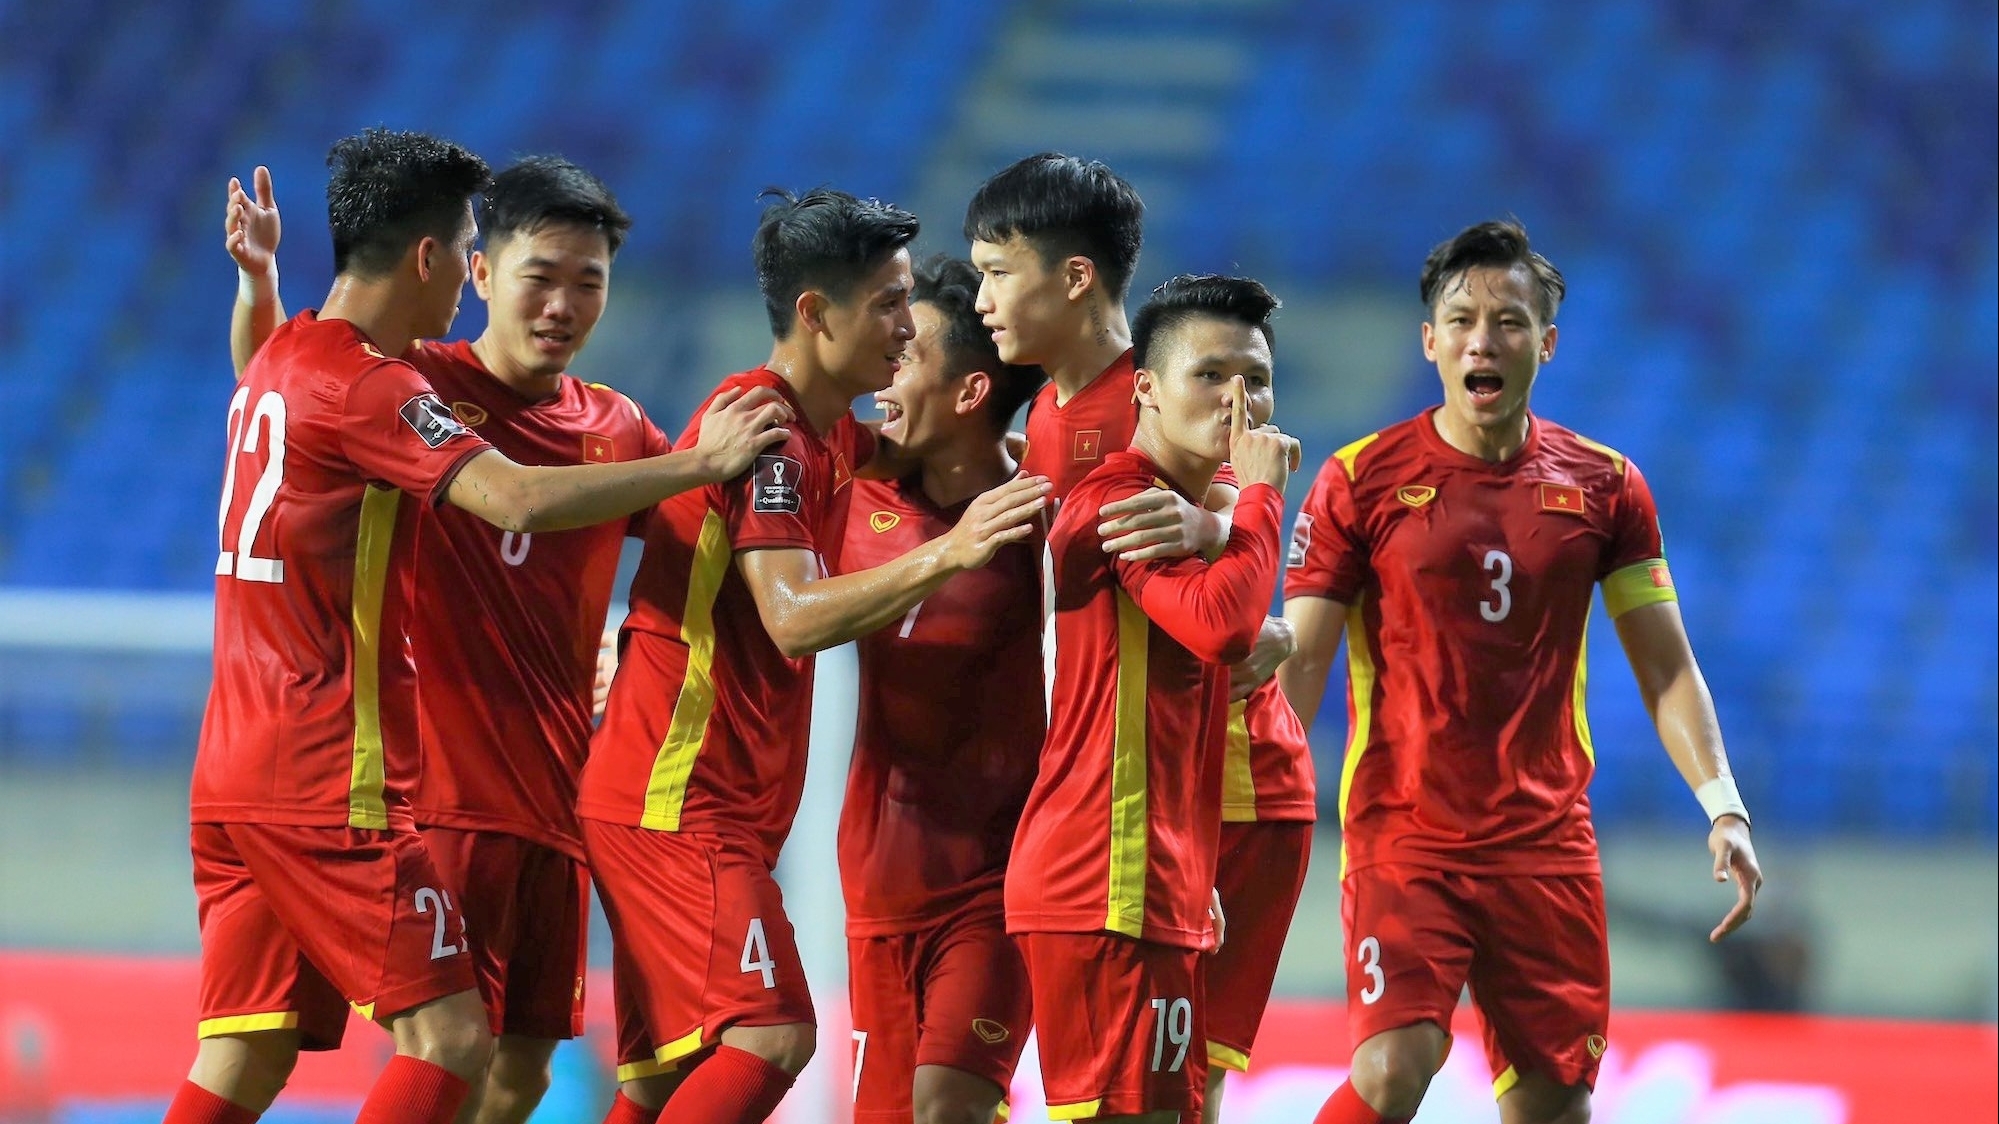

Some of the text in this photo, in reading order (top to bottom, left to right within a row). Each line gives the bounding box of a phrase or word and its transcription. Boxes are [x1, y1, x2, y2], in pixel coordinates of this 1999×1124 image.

[215, 386, 286, 584] 22
[1479, 550, 1513, 623] 3
[740, 918, 776, 989] 4
[1358, 936, 1385, 1005] 3
[1151, 998, 1192, 1073] 19
